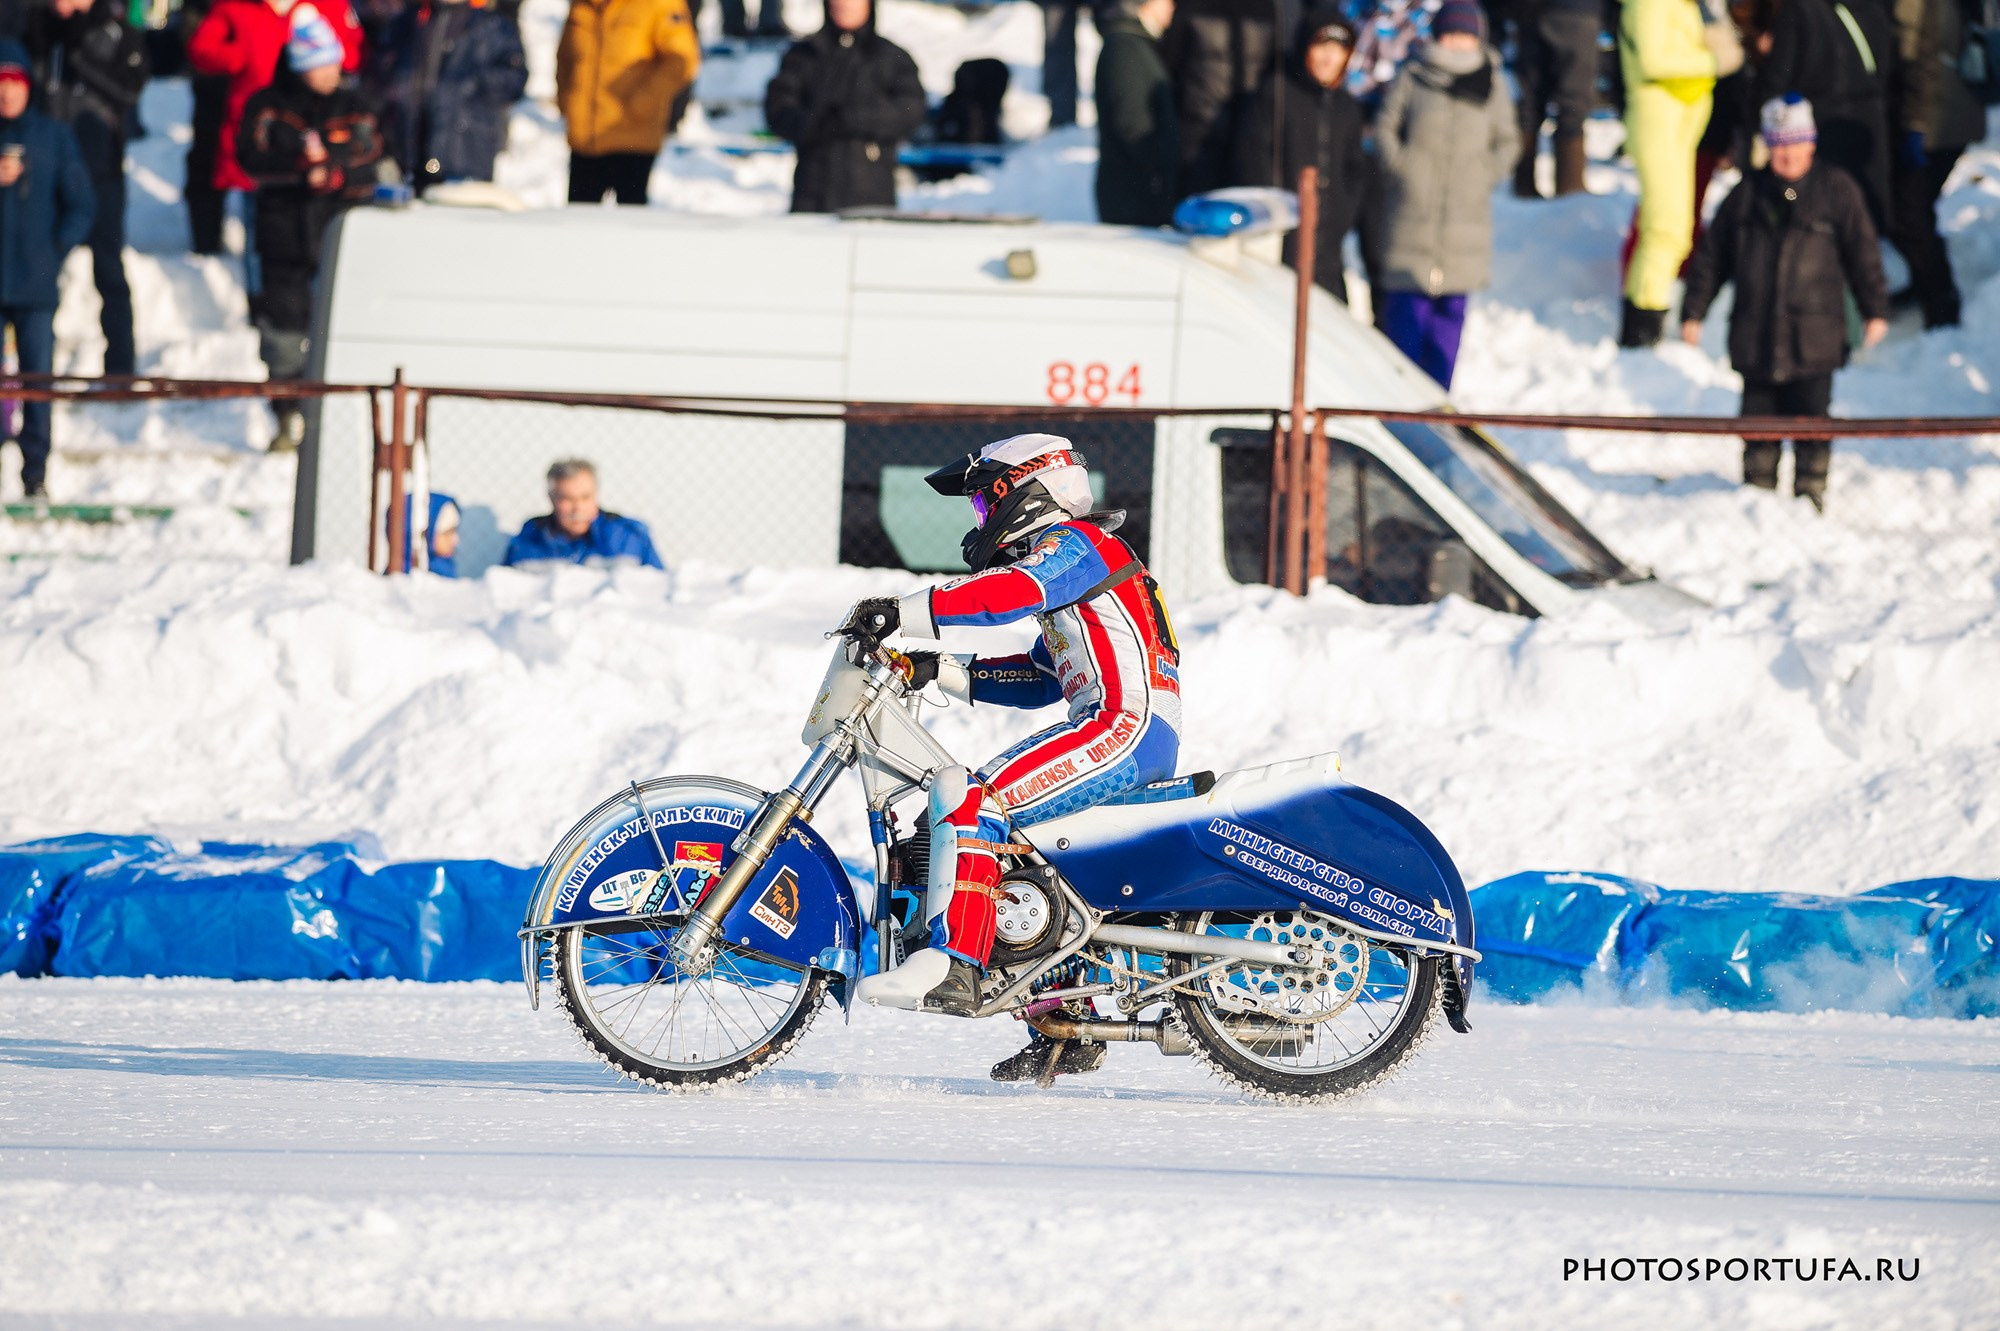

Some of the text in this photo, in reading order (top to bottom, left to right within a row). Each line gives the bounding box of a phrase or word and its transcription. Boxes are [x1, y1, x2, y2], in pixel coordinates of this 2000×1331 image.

[1047, 361, 1141, 406] 884
[1004, 758, 1078, 806] KAMENSK
[557, 806, 746, 913] КАМЕНСК-УРАЛЬСКИЙ
[1208, 818, 1446, 935] МИНИСТЕРСТВО СПОРТА
[772, 884, 791, 917] ТМК
[1237, 850, 1415, 937] СВЕРДЛОВСКОЙ ОБЛАСТИ
